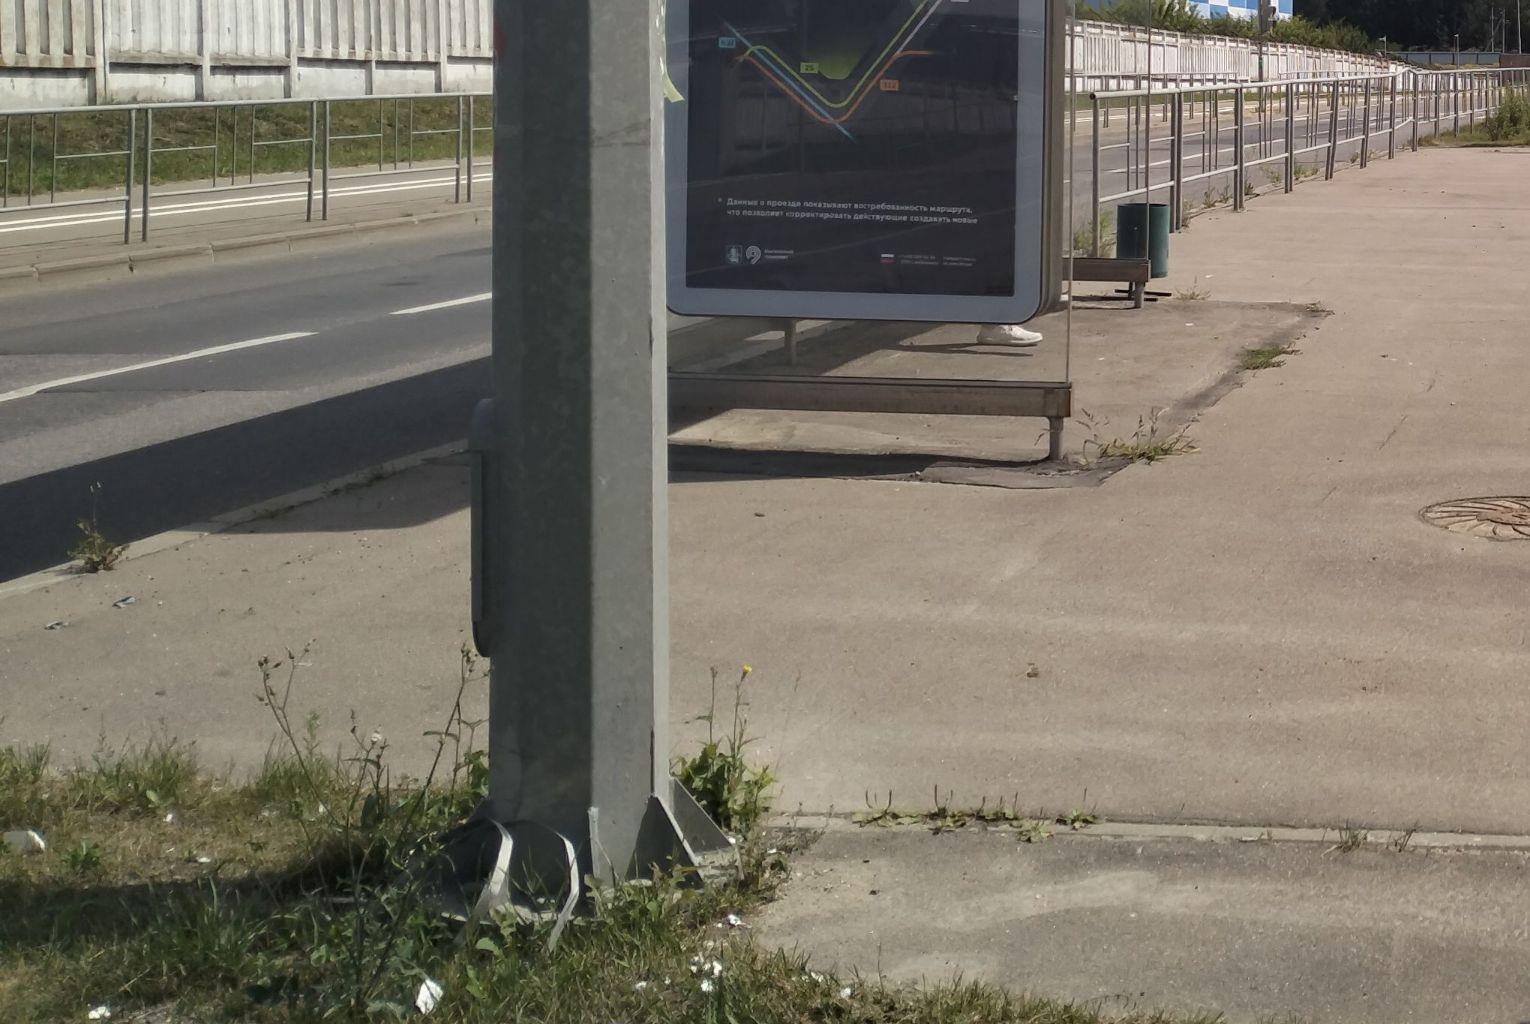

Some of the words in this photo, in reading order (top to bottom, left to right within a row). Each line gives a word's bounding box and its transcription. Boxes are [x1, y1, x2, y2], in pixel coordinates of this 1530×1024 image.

[726, 197, 758, 207] Данные
[766, 200, 802, 208] проезде
[803, 201, 852, 209] показывают
[853, 202, 928, 212] востребованность
[785, 211, 852, 219] корректировать
